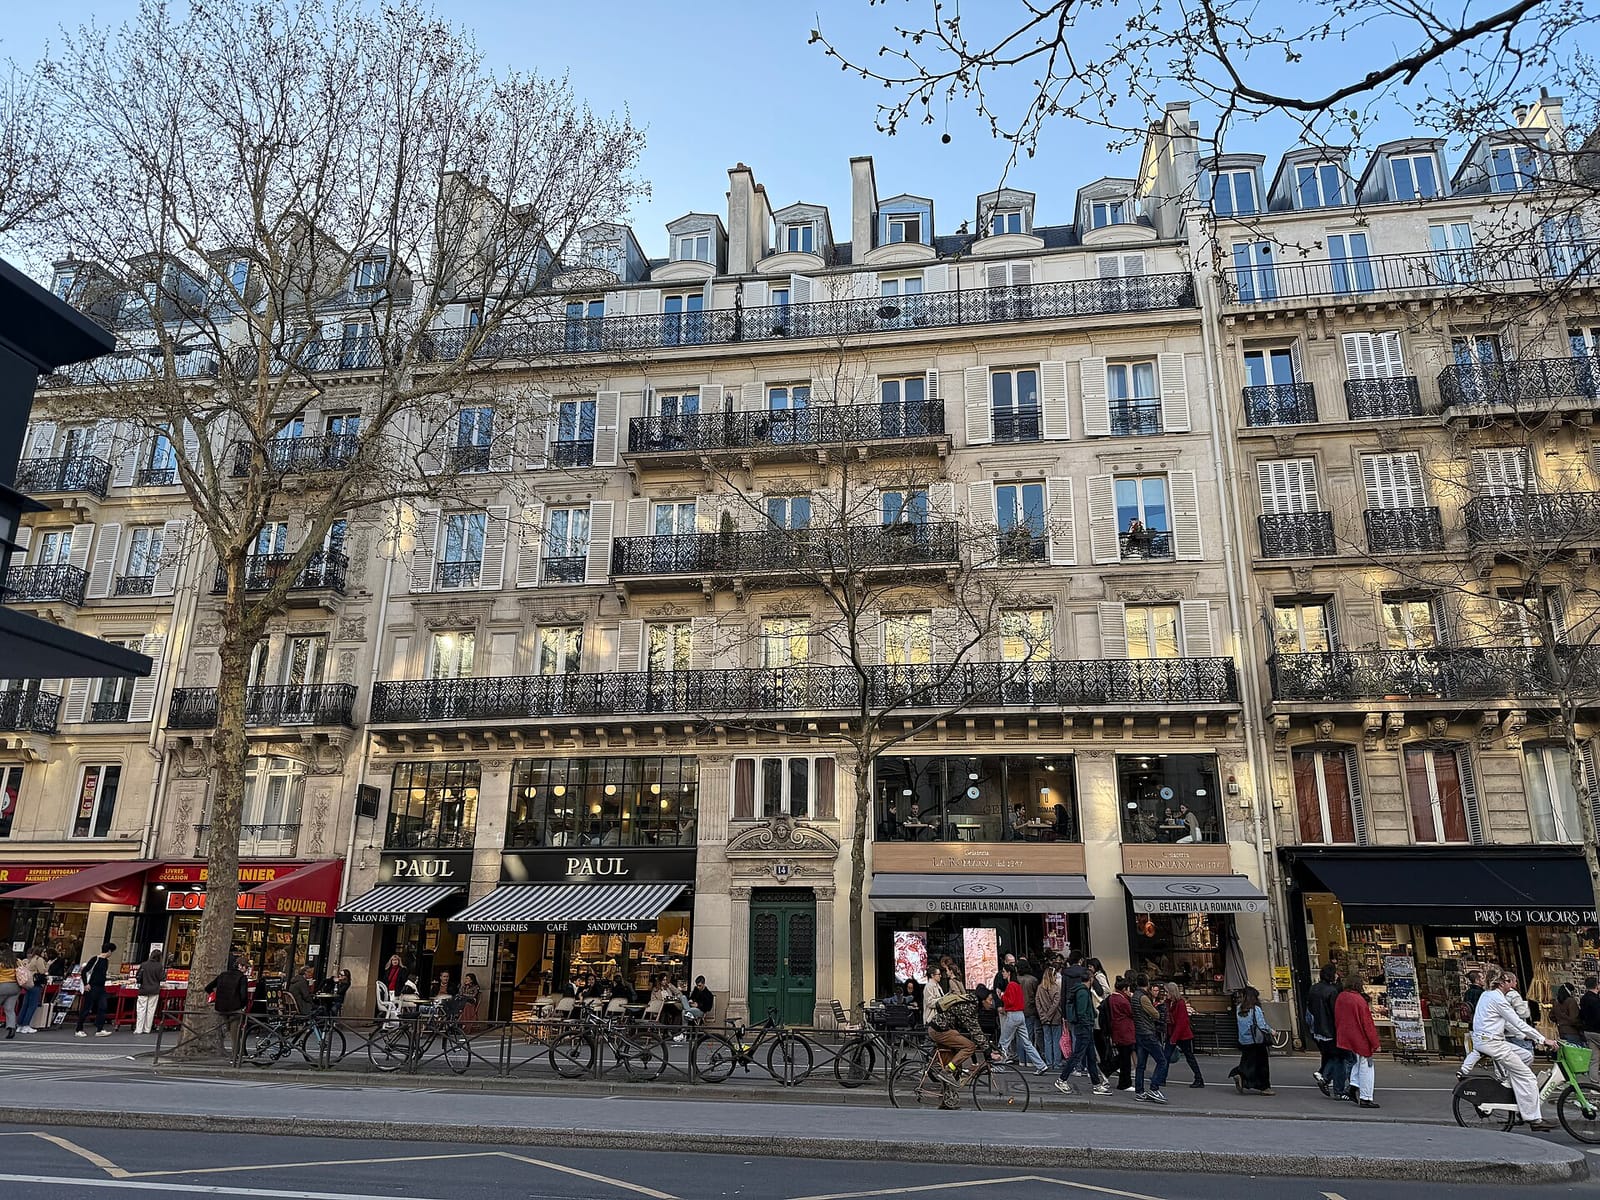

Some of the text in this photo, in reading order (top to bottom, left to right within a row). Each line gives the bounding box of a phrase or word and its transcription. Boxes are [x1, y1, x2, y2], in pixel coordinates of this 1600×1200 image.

[392, 859, 454, 877] PAUL
[565, 857, 629, 876] PAUL
[777, 866, 787, 874] 14
[277, 897, 327, 914] BOULINIER
[940, 901, 1019, 911] GELATERIA LA ROMANA
[1159, 901, 1242, 912] GELATERIA LA ROMANA
[352, 913, 407, 923] SALON DE THÉ
[1474, 910, 1503, 925] PARIS
[1506, 910, 1522, 922] EST
[467, 923, 528, 932] VIENNOISERIES
[546, 922, 568, 932] CAFÉ
[587, 922, 638, 931] SANDWICHS
